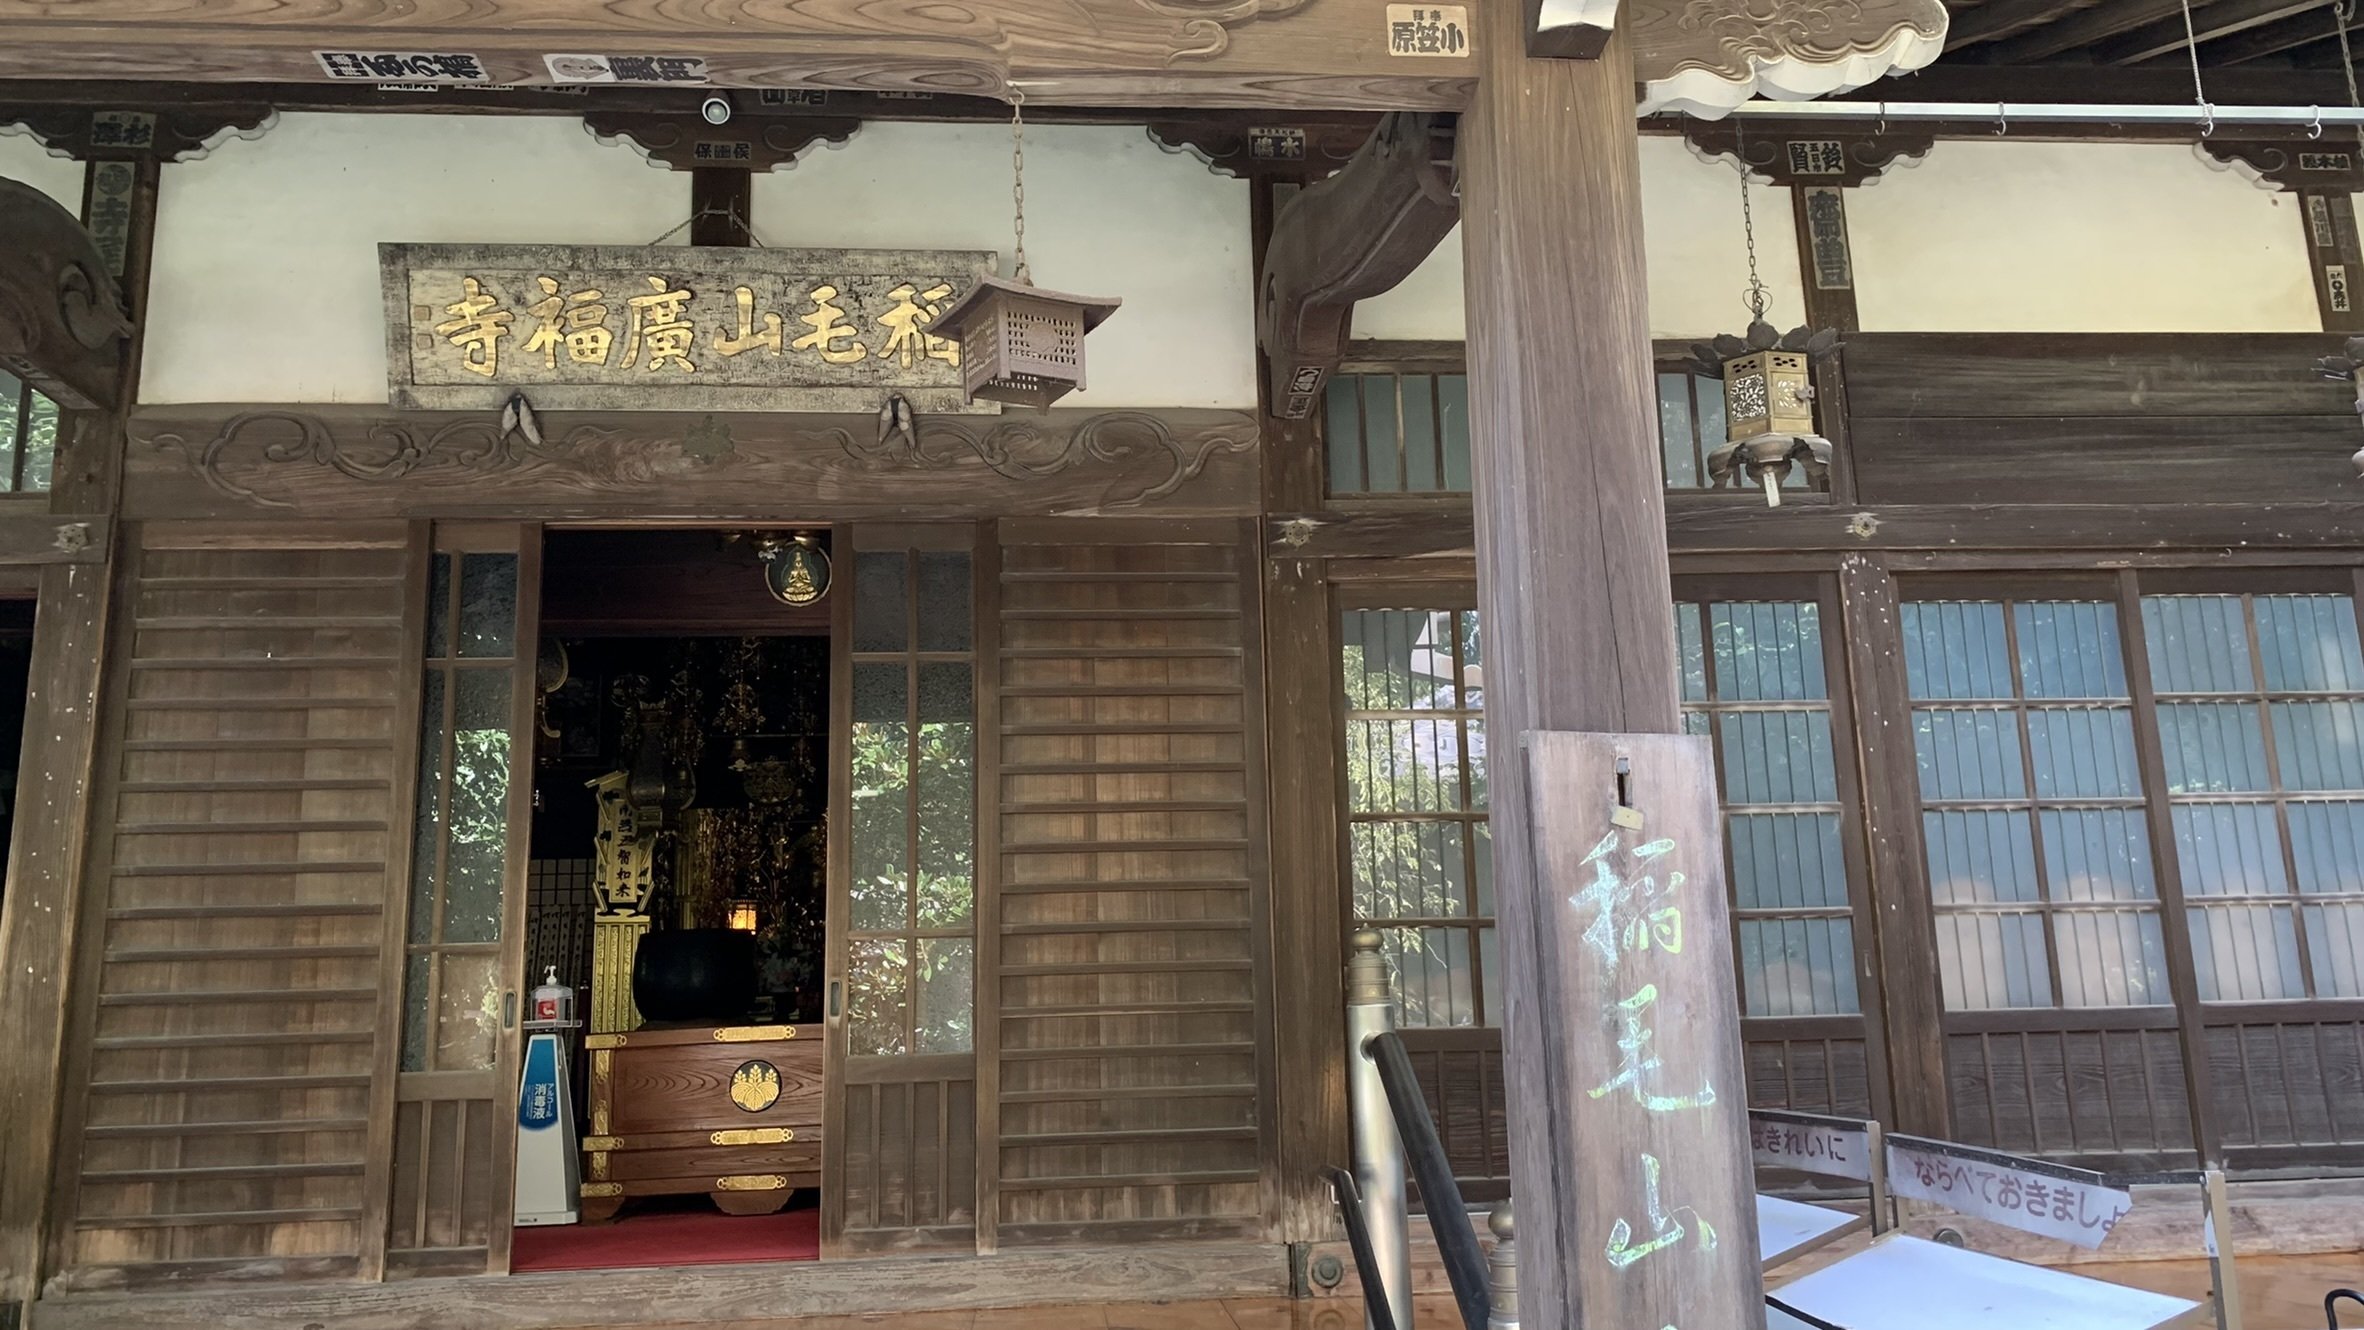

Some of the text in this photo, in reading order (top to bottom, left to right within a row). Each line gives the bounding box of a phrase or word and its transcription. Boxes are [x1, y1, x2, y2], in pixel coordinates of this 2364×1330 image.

[1392, 22, 1465, 54] 小笠原
[1569, 829, 1717, 1330] 稲毛山
[533, 1083, 546, 1119] 消毒液
